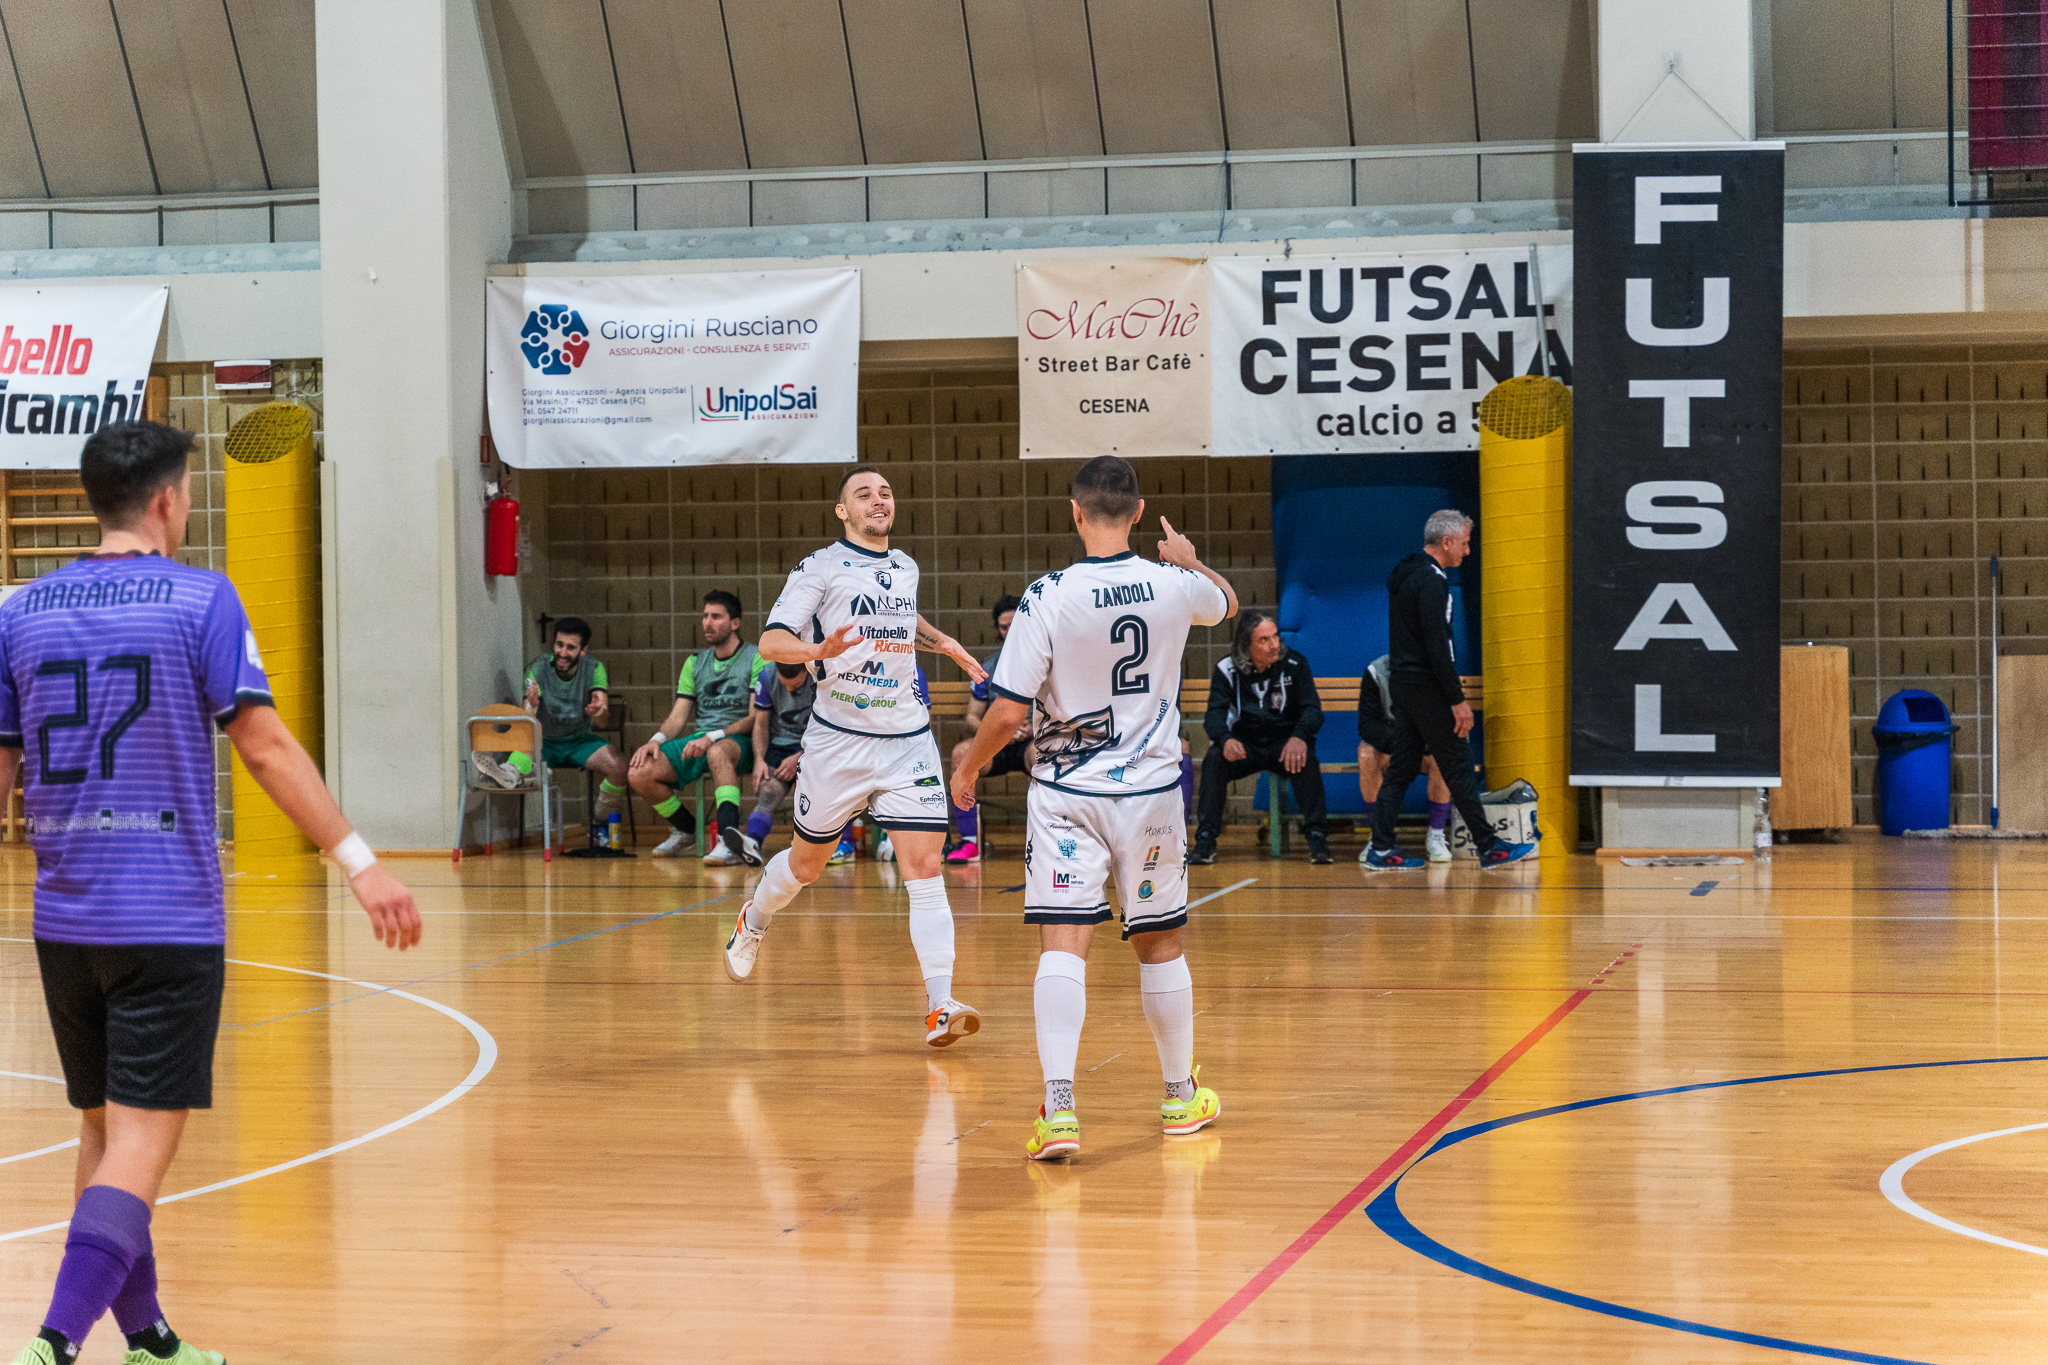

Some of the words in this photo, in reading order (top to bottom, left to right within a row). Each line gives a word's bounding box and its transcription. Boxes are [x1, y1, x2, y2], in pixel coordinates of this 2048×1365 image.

[1261, 261, 1555, 326] FUTSAL
[600, 319, 695, 344] Giorgini
[705, 315, 818, 338] Rusciano
[1026, 297, 1200, 340] MaChè
[0, 324, 93, 375] bello
[608, 346, 685, 357] ASSICURAZIONI
[692, 344, 761, 355] CONSULENZA
[764, 344, 770, 352] E
[772, 342, 811, 352] SERVIZI
[1239, 328, 1574, 395] CESENA
[1038, 356, 1099, 373] Street
[1106, 355, 1140, 372] Bar
[1146, 353, 1192, 371] Cafè
[521, 388, 553, 397] Giorgini
[555, 387, 608, 396] Assicurazioni
[615, 388, 647, 397] Agenzia
[649, 385, 687, 396] UnipolSai
[522, 398, 534, 406] Via
[576, 397, 598, 405] 47521
[600, 397, 628, 405] Cesena
[630, 396, 646, 406] (FC)
[706, 383, 818, 421] UnipolSai
[522, 407, 536, 415] Tel.
[537, 407, 556, 415] 0547
[557, 407, 579, 415] 24711
[1079, 399, 1150, 413] CESENA
[522, 416, 653, 426] giorginiassicurazioni@gmail.com
[1317, 405, 1422, 436] calcio
[1437, 411, 1456, 433] a
[1613, 175, 1739, 753] FUTSAL
[25, 579, 173, 614] MARANGON
[877, 594, 915, 611] ALPH
[1092, 581, 1155, 609] ZANDOLI
[859, 625, 908, 640] Vitobello
[1110, 614, 1150, 697] 2
[838, 672, 899, 688] NEXTMEDIA
[831, 690, 854, 704] PIERI
[870, 699, 897, 709] GROUP
[36, 655, 150, 785] 27
[1145, 825, 1173, 836] HORUS
